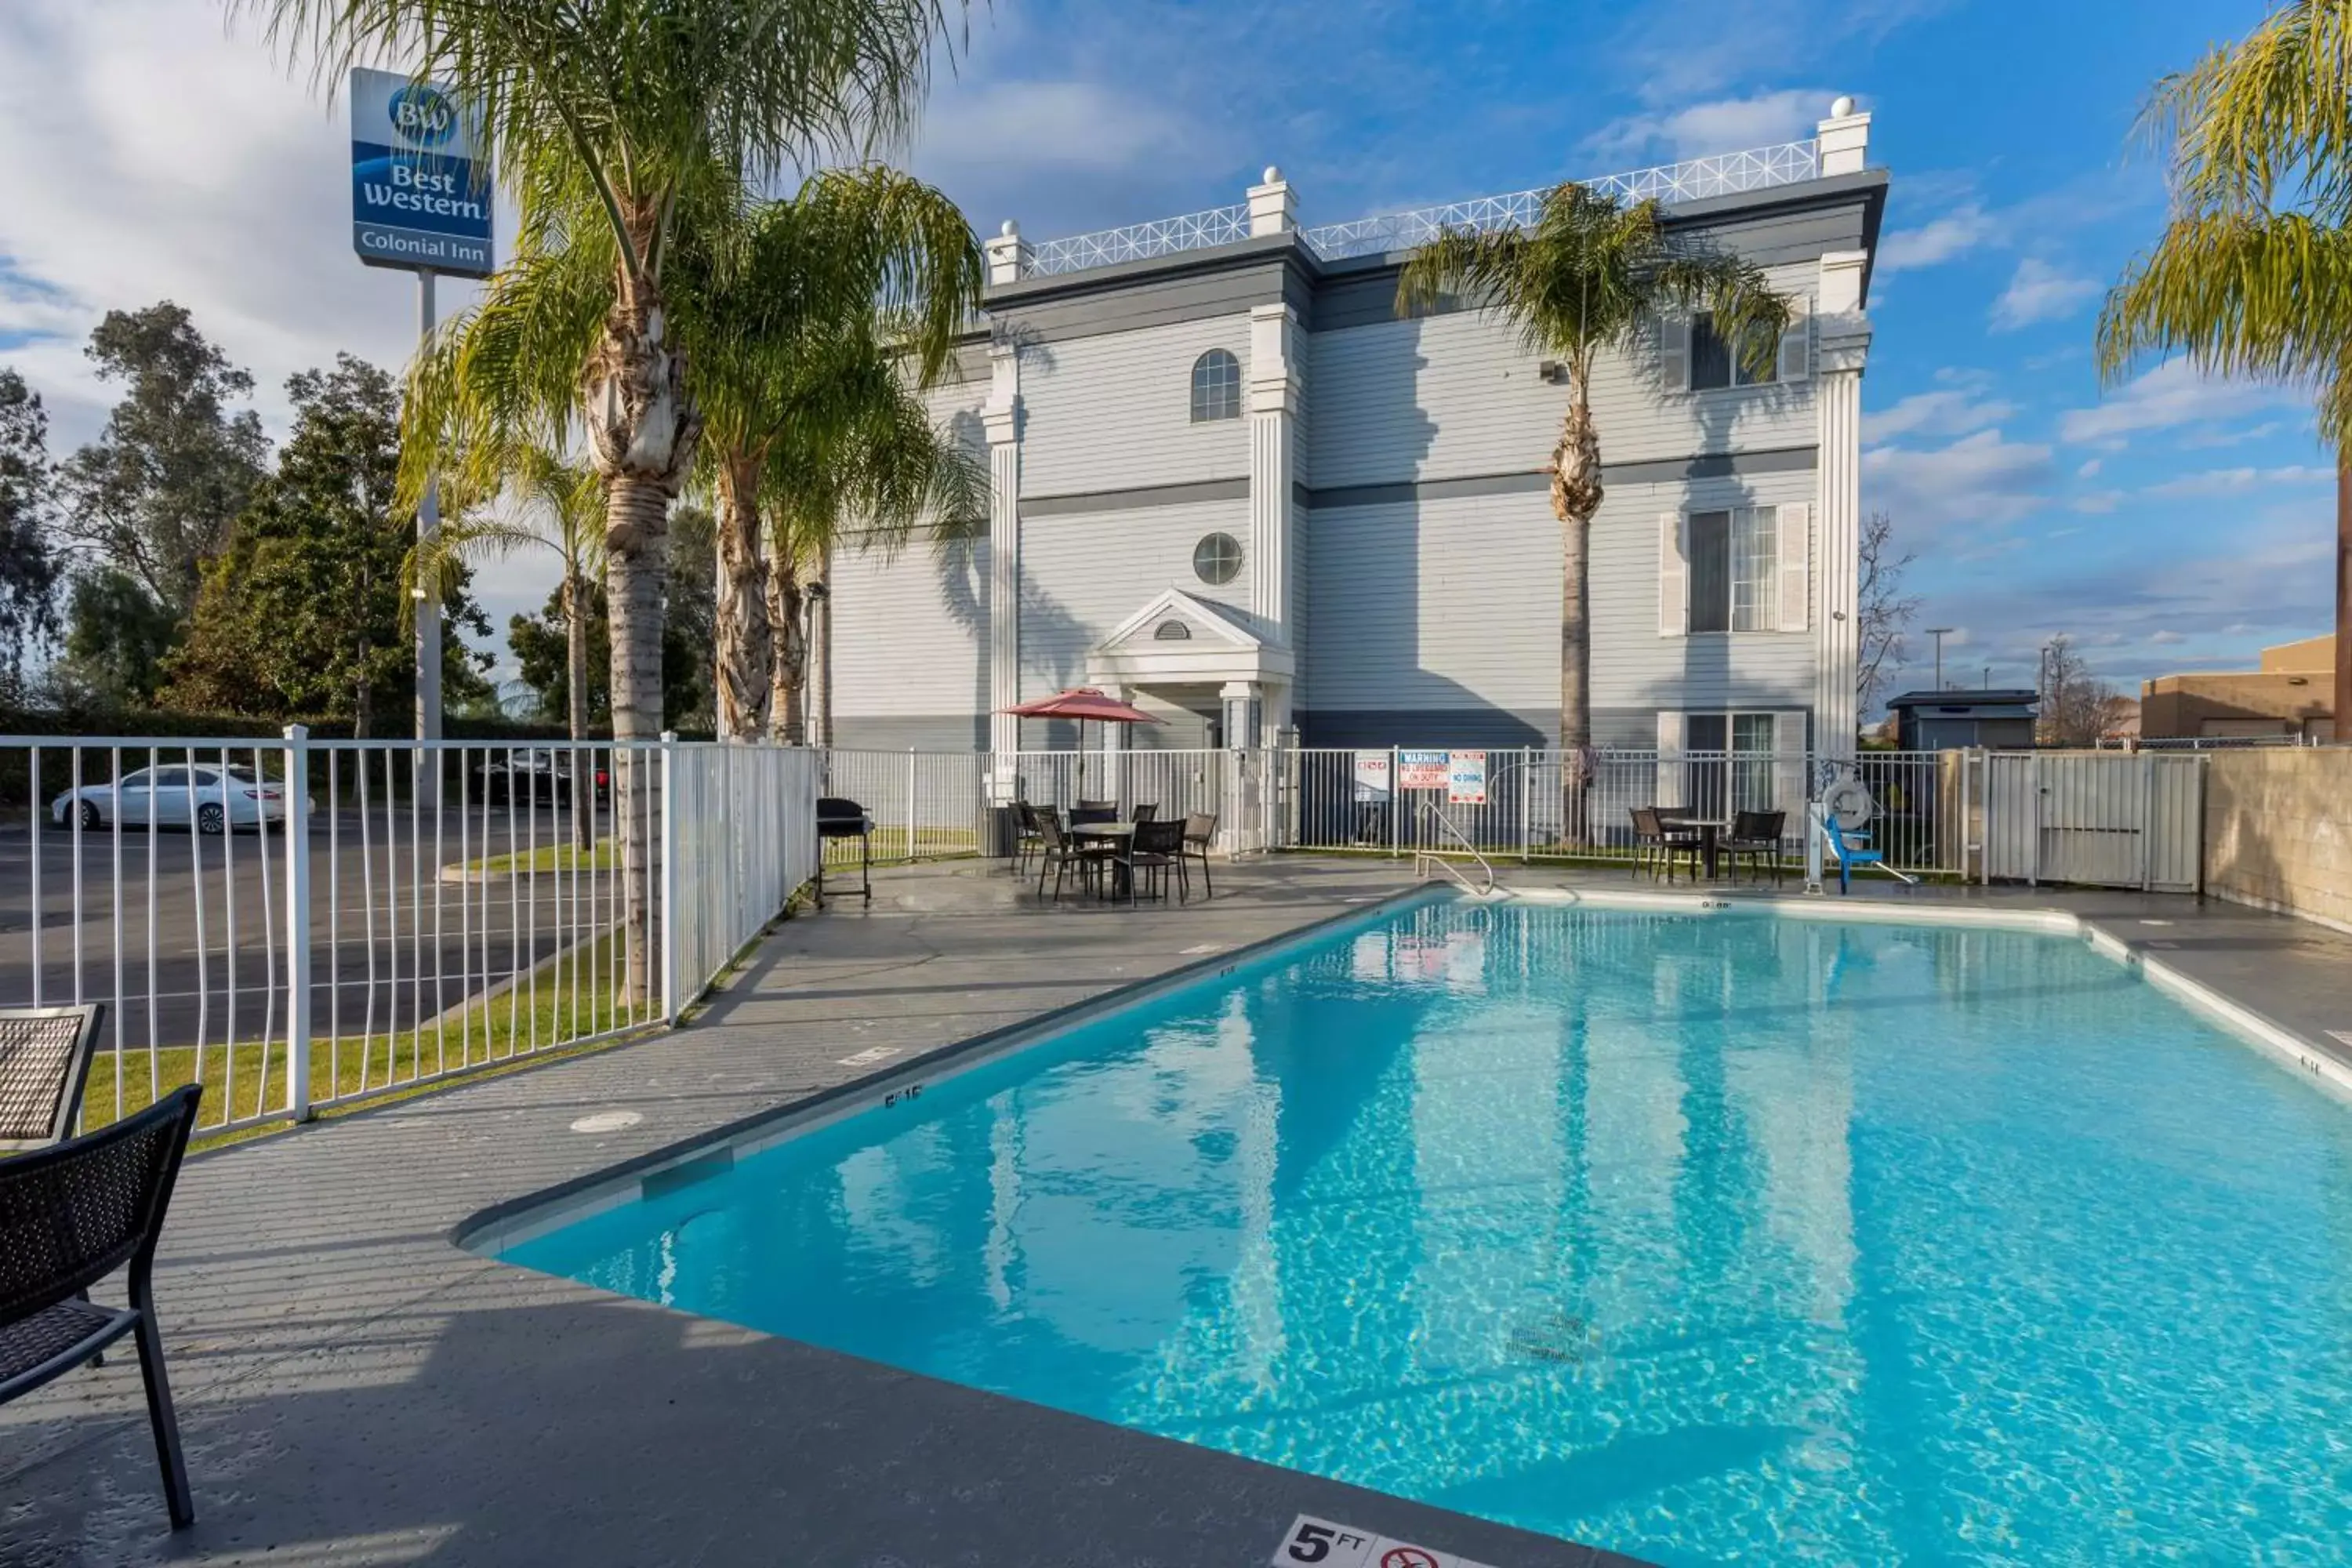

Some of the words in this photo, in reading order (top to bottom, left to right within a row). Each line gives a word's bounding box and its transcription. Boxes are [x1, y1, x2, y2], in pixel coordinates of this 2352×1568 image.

[397, 102, 448, 131] BW
[393, 165, 456, 194] Best
[361, 232, 445, 256] Colonial
[452, 244, 485, 262] Inn
[1404, 753, 1446, 763] WARNING
[1288, 1523, 1334, 1563] 5
[1337, 1533, 1366, 1550] FT
